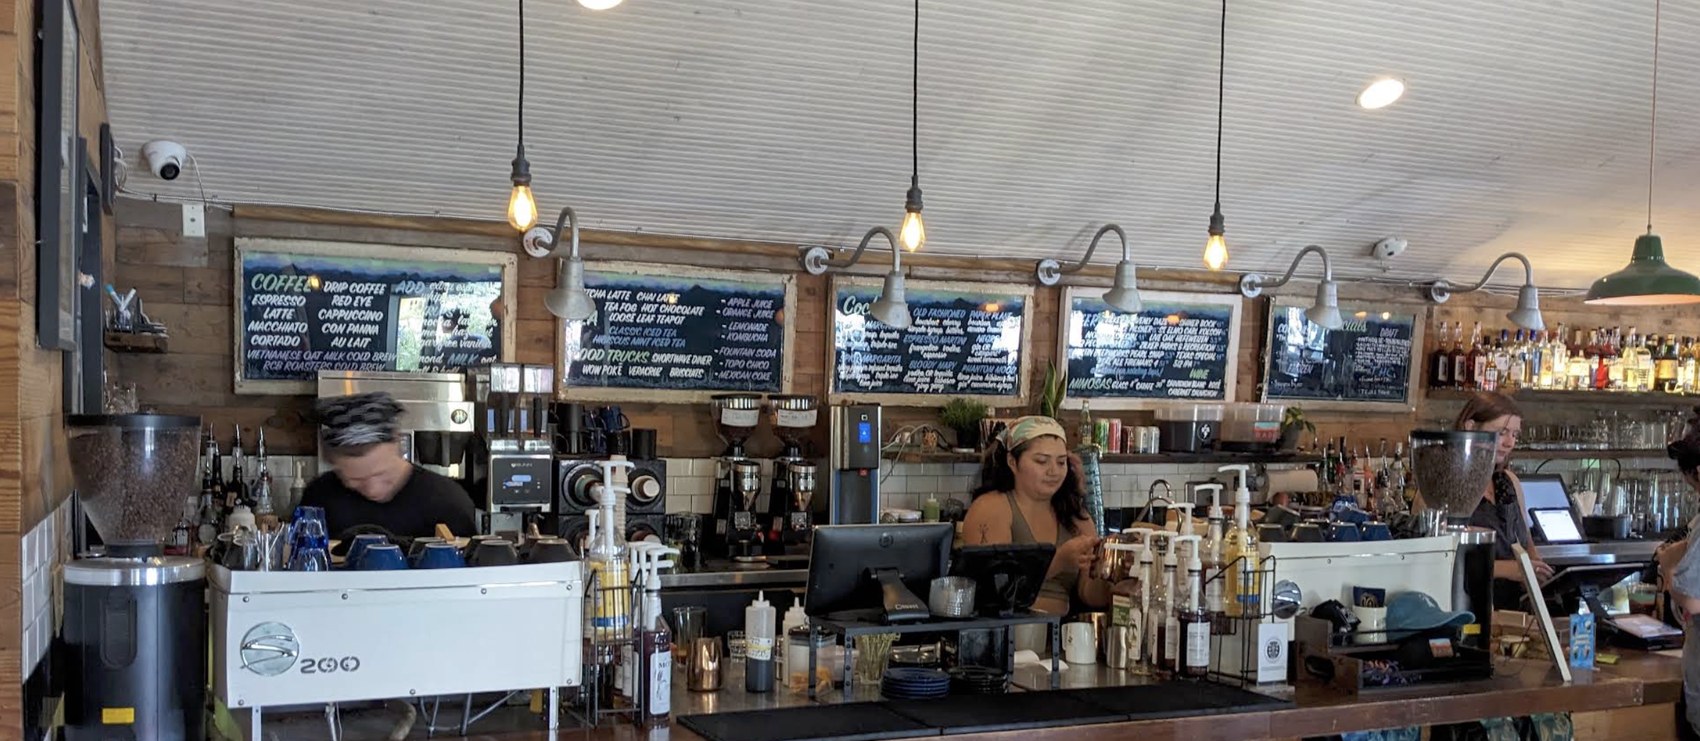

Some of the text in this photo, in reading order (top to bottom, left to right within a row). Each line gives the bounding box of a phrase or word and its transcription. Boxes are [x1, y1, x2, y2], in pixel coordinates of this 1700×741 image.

[323, 281, 386, 294] DRIP COFFEE
[396, 280, 426, 292] ADD
[251, 294, 306, 306] ESPRESSO
[331, 295, 374, 306] RED EYE
[608, 290, 631, 300] LATTE
[636, 292, 656, 300] CHAI
[727, 298, 773, 308] APPLE JUICE
[263, 307, 294, 319] LATTE
[318, 309, 383, 320] CAPPUCCINO
[604, 302, 704, 316] TEA FOG HOT CHOCOLATE
[722, 307, 774, 318] ORANGE JUICE
[913, 307, 966, 318] OLD FASHIONED
[609, 312, 636, 322] LOOSE
[636, 314, 656, 323] LEAF
[656, 314, 685, 325] TEAPOT
[248, 320, 308, 333] MACCHIATO
[322, 323, 378, 334] CON PANNA
[608, 326, 678, 337] CLASSIC ICED TEA
[728, 322, 768, 332] LEMONADE
[250, 334, 300, 346] CORTADO
[331, 336, 372, 348] AU LAIT
[592, 334, 685, 348] HIBISCUS MINT ICED TEA
[726, 332, 768, 342] KOMBUCHA
[904, 334, 938, 344] ESPRESSO
[1162, 334, 1175, 342] OAK
[246, 349, 398, 362] VIETNAMESE OAT MILK COLD BREW
[580, 348, 604, 360] OOD
[608, 350, 650, 363] TRUCKS
[692, 354, 712, 366] DINER
[720, 346, 776, 358] FOUNTAIN SODA
[447, 353, 478, 364] MILK
[284, 362, 332, 371] ROASTERS
[334, 362, 358, 370] COLD
[582, 364, 601, 375] WOW
[628, 365, 662, 377] VERACRUZ
[724, 360, 769, 370] TOPO CHICO
[908, 360, 957, 370] BLOODY MARY
[718, 372, 772, 380] MEXICAN COKE
[1068, 378, 1112, 389] MIMOSAS
[300, 656, 360, 674] 200
